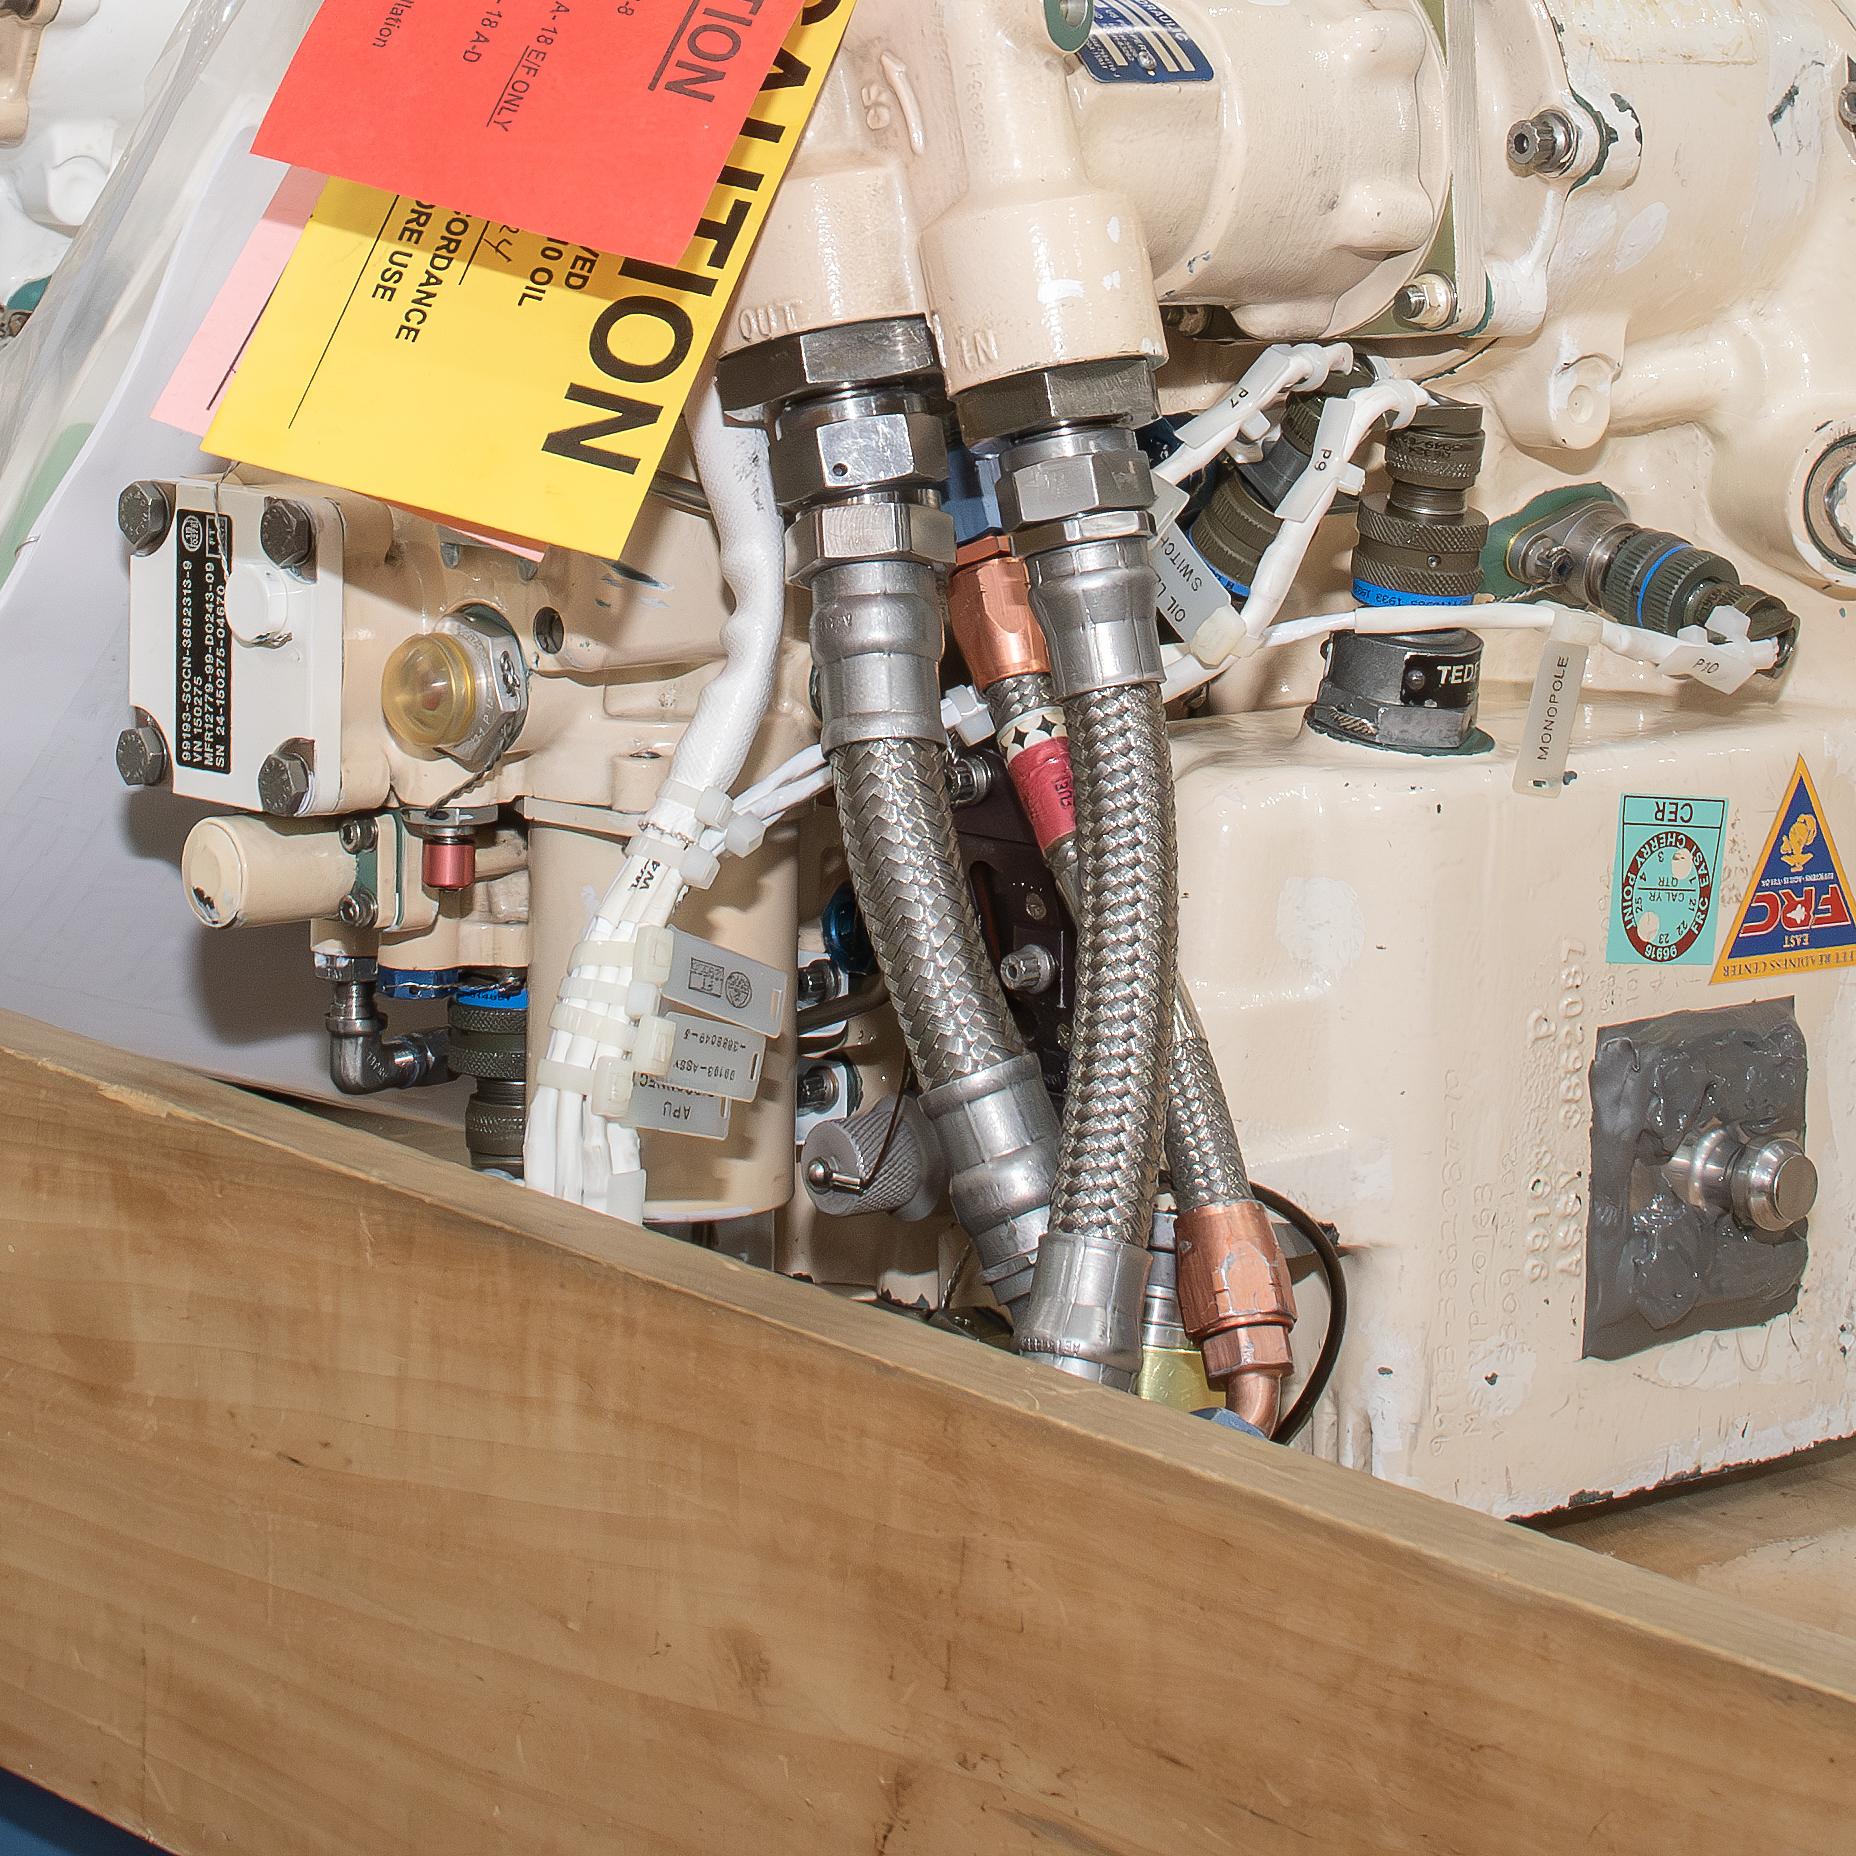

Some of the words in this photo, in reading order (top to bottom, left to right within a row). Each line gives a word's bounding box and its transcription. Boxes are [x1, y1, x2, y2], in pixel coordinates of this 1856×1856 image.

[493, 78, 531, 133] ONLY
[371, 250, 414, 302] USE
[395, 208, 472, 343] ORDANCE
[517, 266, 555, 307] OIL
[1228, 387, 1250, 410] P7
[1164, 588, 1187, 623] OIL
[192, 675, 204, 737] 150275
[1536, 655, 1571, 762] MONOPOLE
[191, 741, 204, 764] VN
[214, 743, 226, 768] SN
[1653, 800, 1694, 825] CER
[1635, 831, 1688, 870] CHERRY
[1622, 872, 1637, 930] POINT
[1648, 891, 1663, 902] YR
[1667, 891, 1685, 903] CAL
[1738, 883, 1852, 938] FRC
[1690, 896, 1710, 936] FRC
[1782, 933, 1810, 948] EAST
[1722, 960, 1768, 977] CENTER
[1770, 952, 1832, 972] READINESS
[661, 1100, 692, 1121] APU
